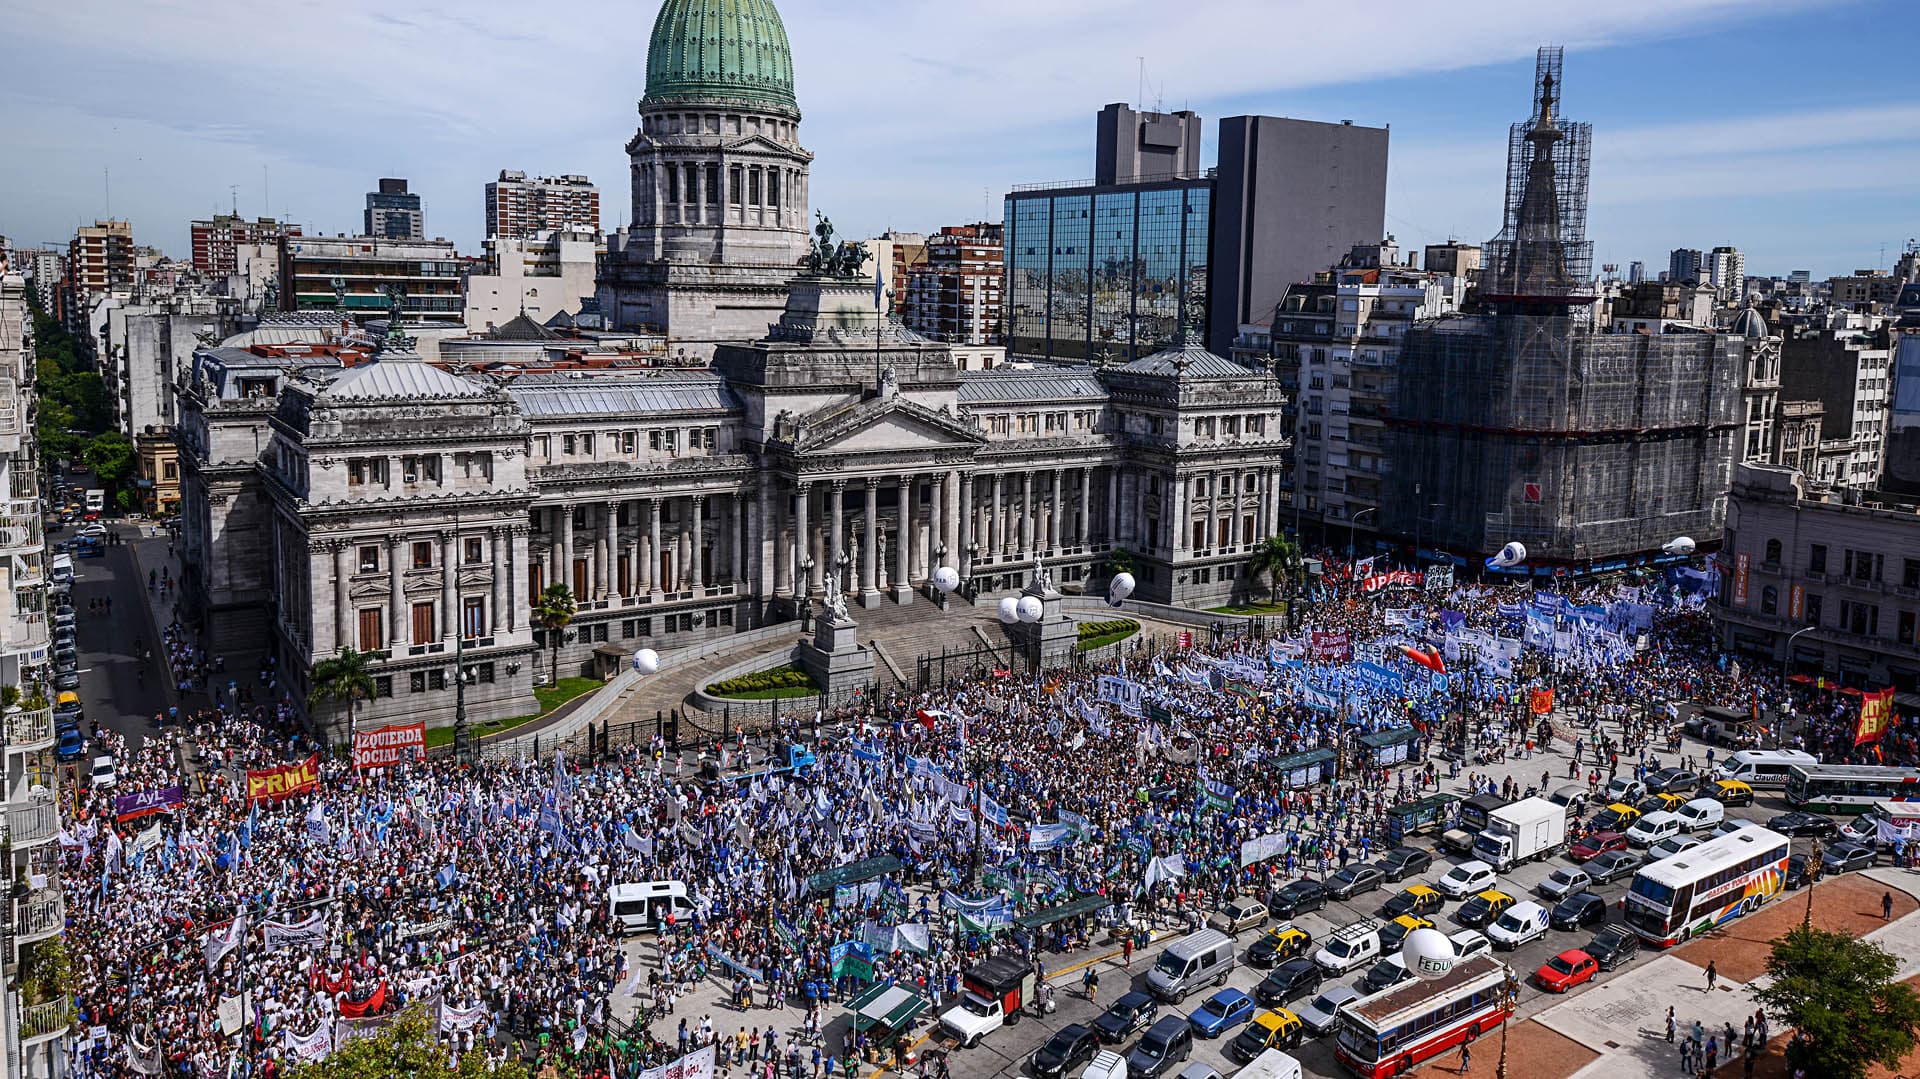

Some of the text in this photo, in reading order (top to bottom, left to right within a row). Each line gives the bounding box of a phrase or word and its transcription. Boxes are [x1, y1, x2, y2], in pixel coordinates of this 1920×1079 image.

[356, 728, 423, 749] IZQUIERDA
[353, 744, 426, 766] SOCIALA
[249, 765, 317, 797] PRML
[135, 790, 164, 806] AyL
